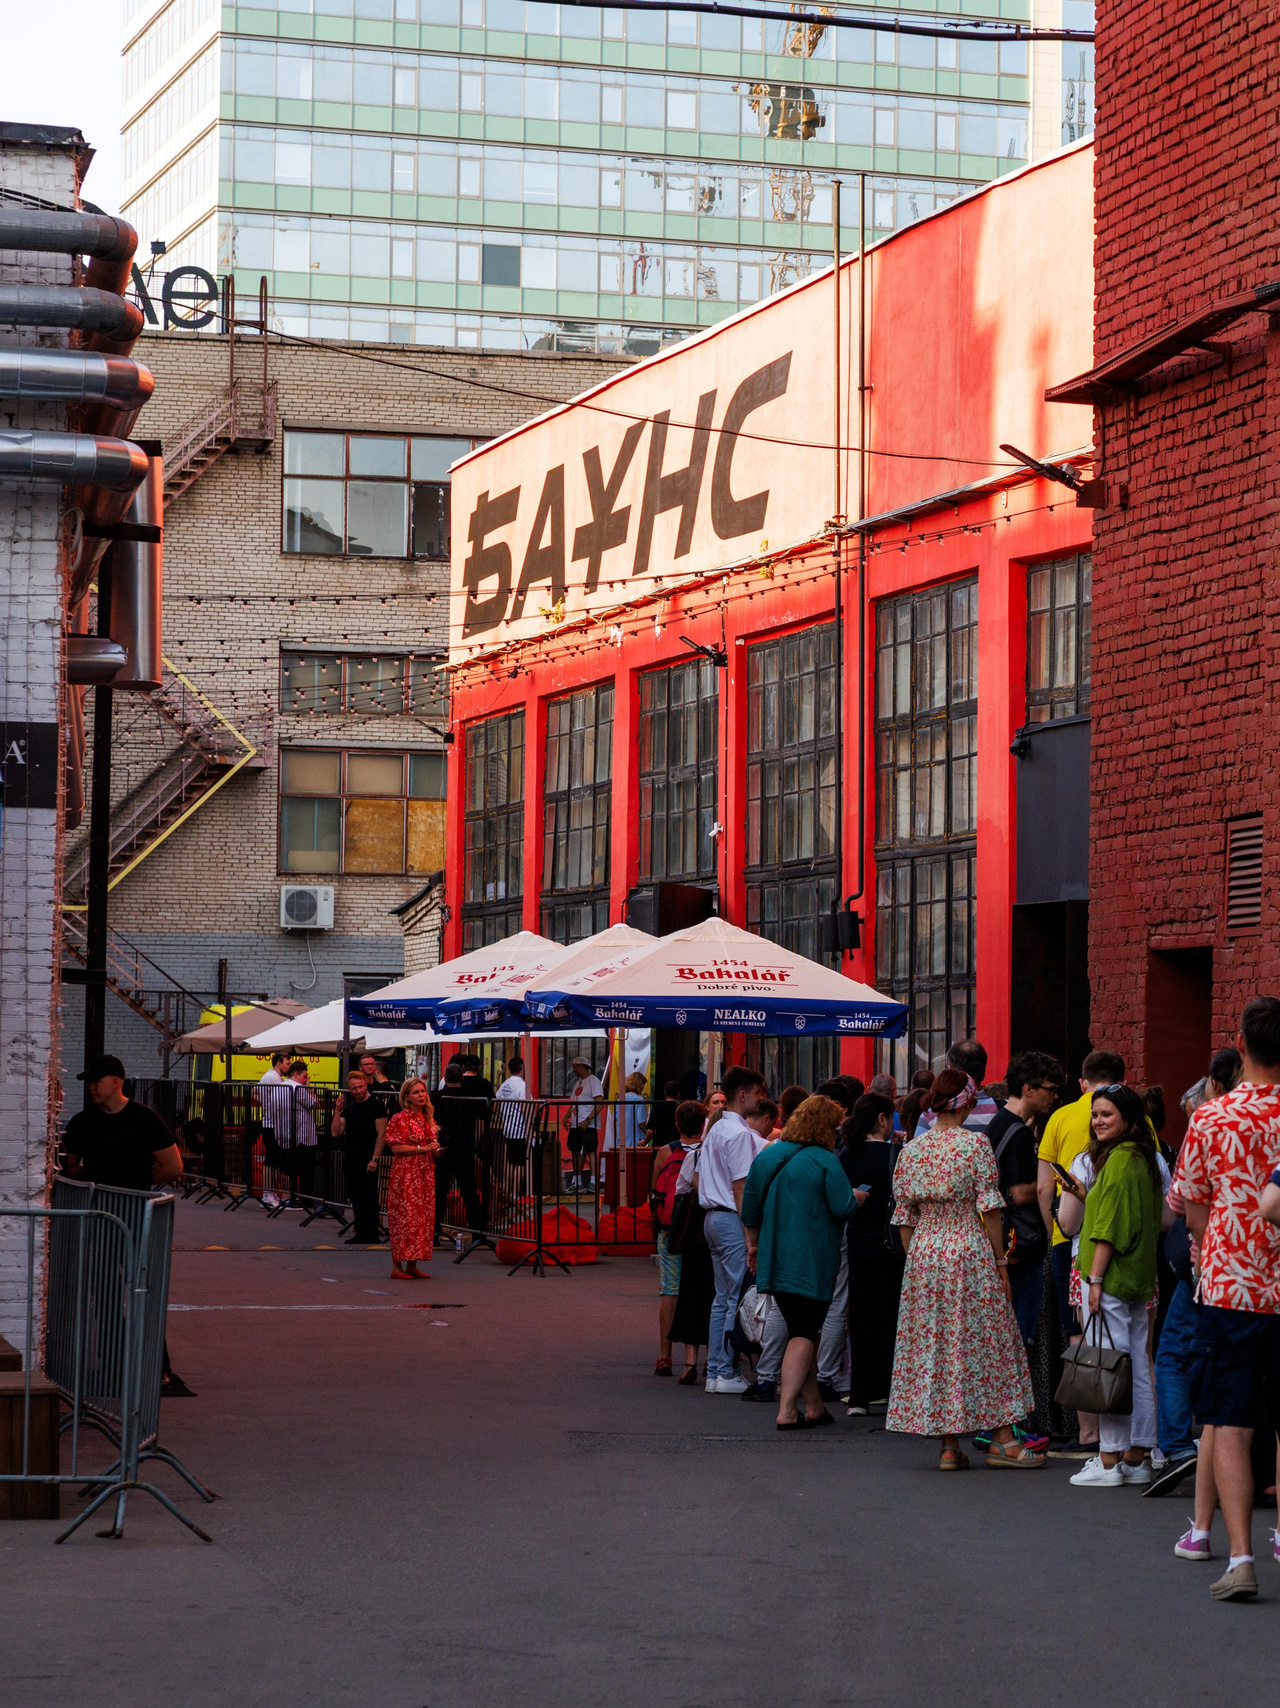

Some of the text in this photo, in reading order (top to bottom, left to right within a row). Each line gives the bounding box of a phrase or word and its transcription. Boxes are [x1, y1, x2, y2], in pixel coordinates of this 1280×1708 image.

[711, 959, 749, 967] 1454
[675, 967, 791, 982] Bakalář
[742, 984, 776, 992] pivo.
[594, 1007, 643, 1021] Bakalář
[714, 1008, 767, 1021] NEALKO
[837, 1018, 885, 1030] Bakalář
